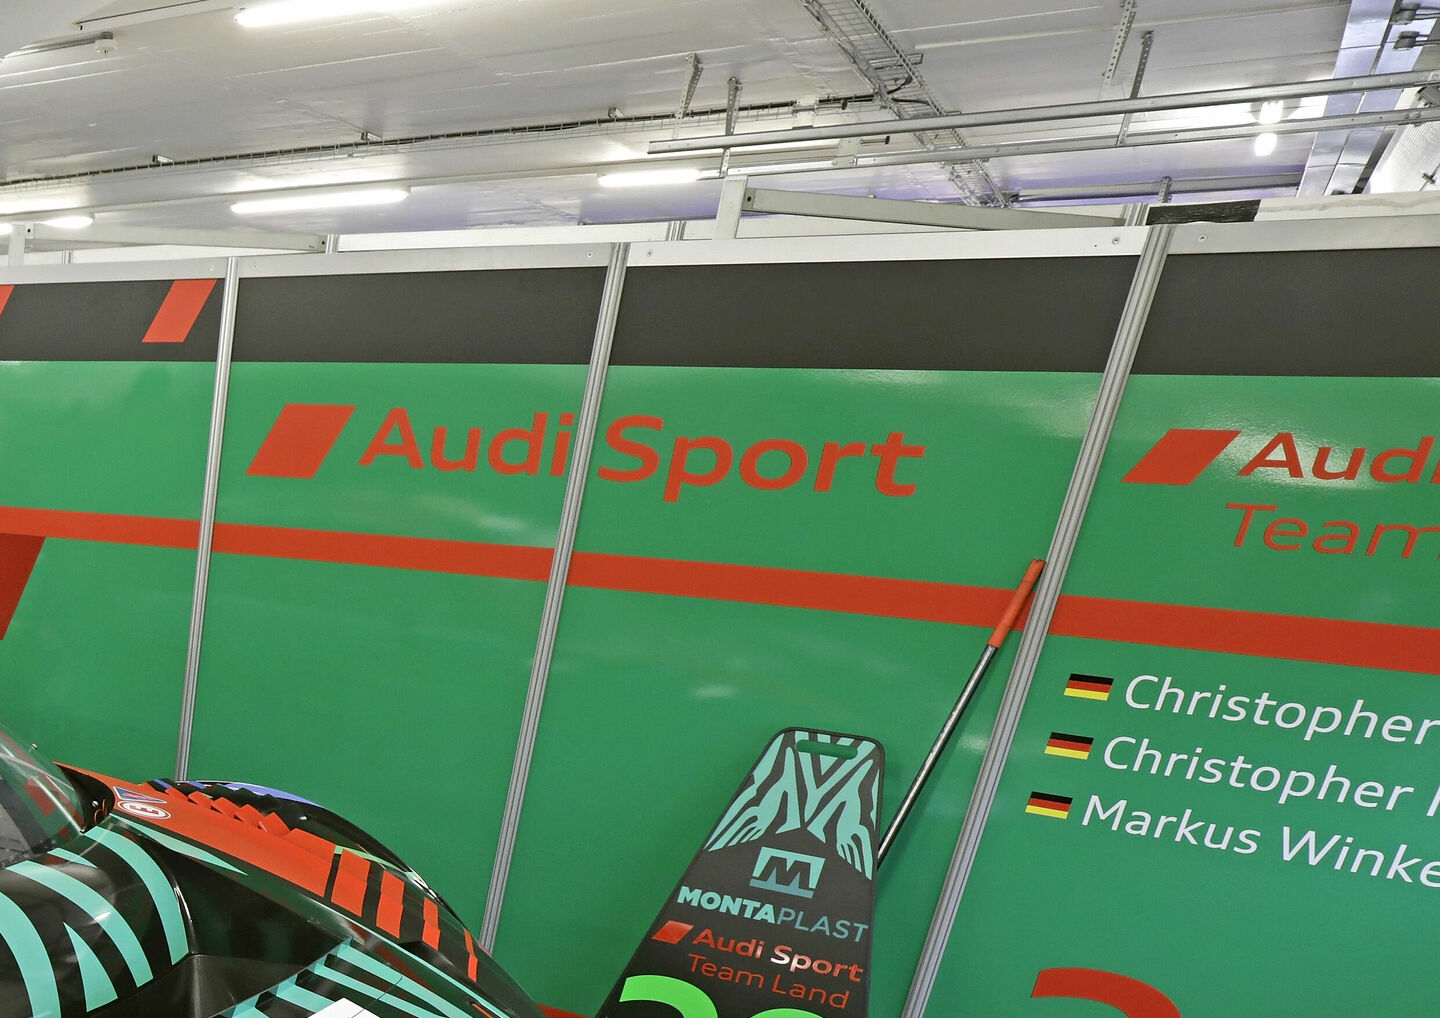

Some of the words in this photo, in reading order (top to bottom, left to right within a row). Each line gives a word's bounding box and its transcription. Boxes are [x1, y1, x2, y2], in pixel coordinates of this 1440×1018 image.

[359, 407, 573, 477] Audi
[598, 415, 926, 503] Sport
[1236, 432, 1440, 485] Aud
[1125, 675, 1440, 745] Christopher
[1103, 736, 1415, 812] Christopher
[1082, 795, 1262, 855] Markus
[677, 885, 869, 943] MONTAPLAST
[688, 953, 765, 988] Team
[772, 974, 850, 1009] Land
[692, 928, 765, 959] Audi
[770, 945, 864, 983] Sport
